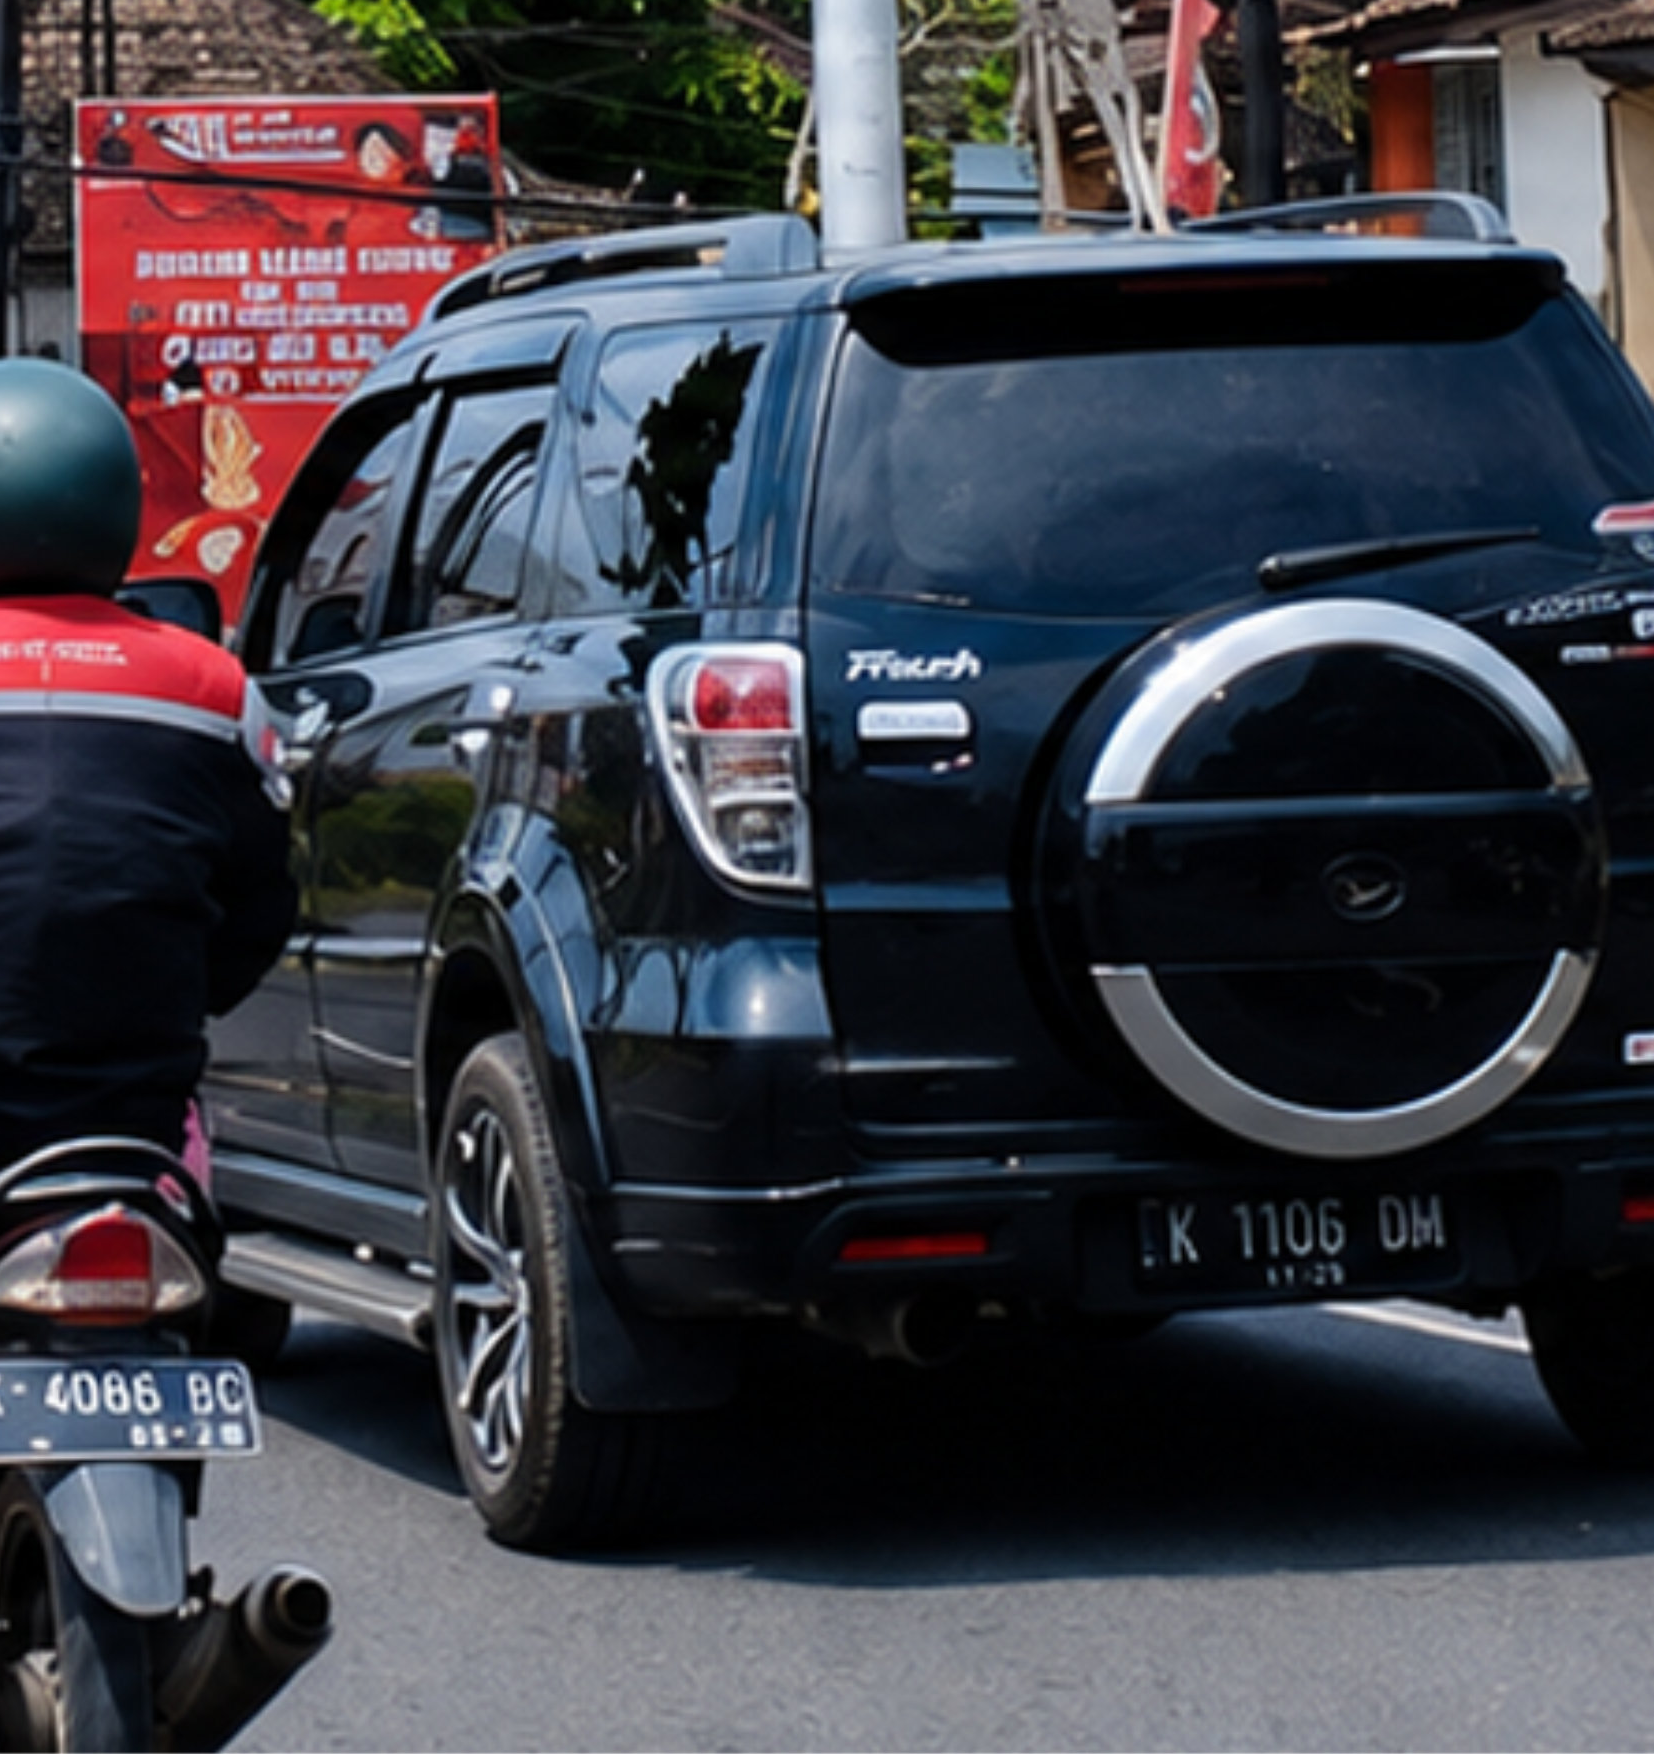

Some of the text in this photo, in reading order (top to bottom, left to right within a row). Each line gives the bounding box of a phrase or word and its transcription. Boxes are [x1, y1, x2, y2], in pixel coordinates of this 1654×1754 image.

[1168, 1204, 1199, 1263] K
[1233, 1198, 1346, 1259] 1106
[44, 1369, 161, 1415] 4086
